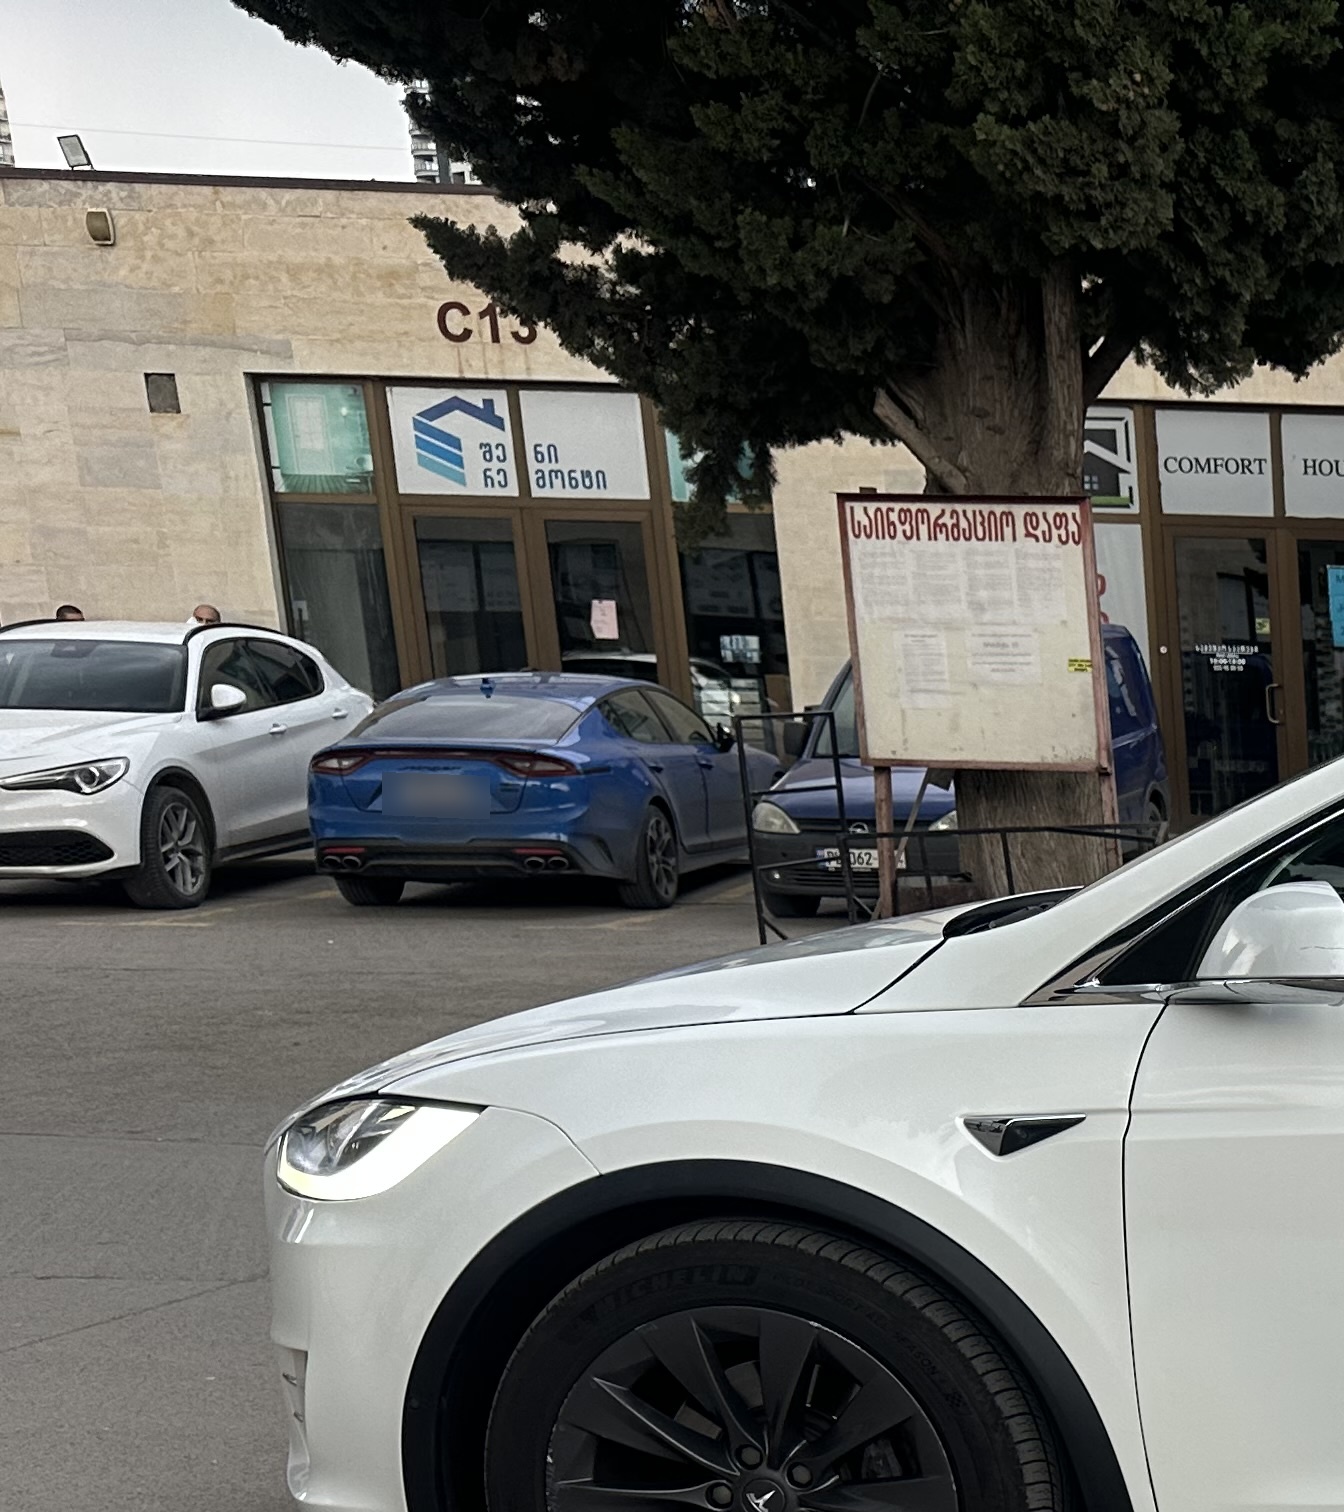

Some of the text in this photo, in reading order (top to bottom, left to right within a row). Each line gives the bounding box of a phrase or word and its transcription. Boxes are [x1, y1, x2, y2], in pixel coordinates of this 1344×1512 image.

[1163, 456, 1268, 475] COMFORT
[849, 505, 1083, 546] საინფორმაციო დაფა
